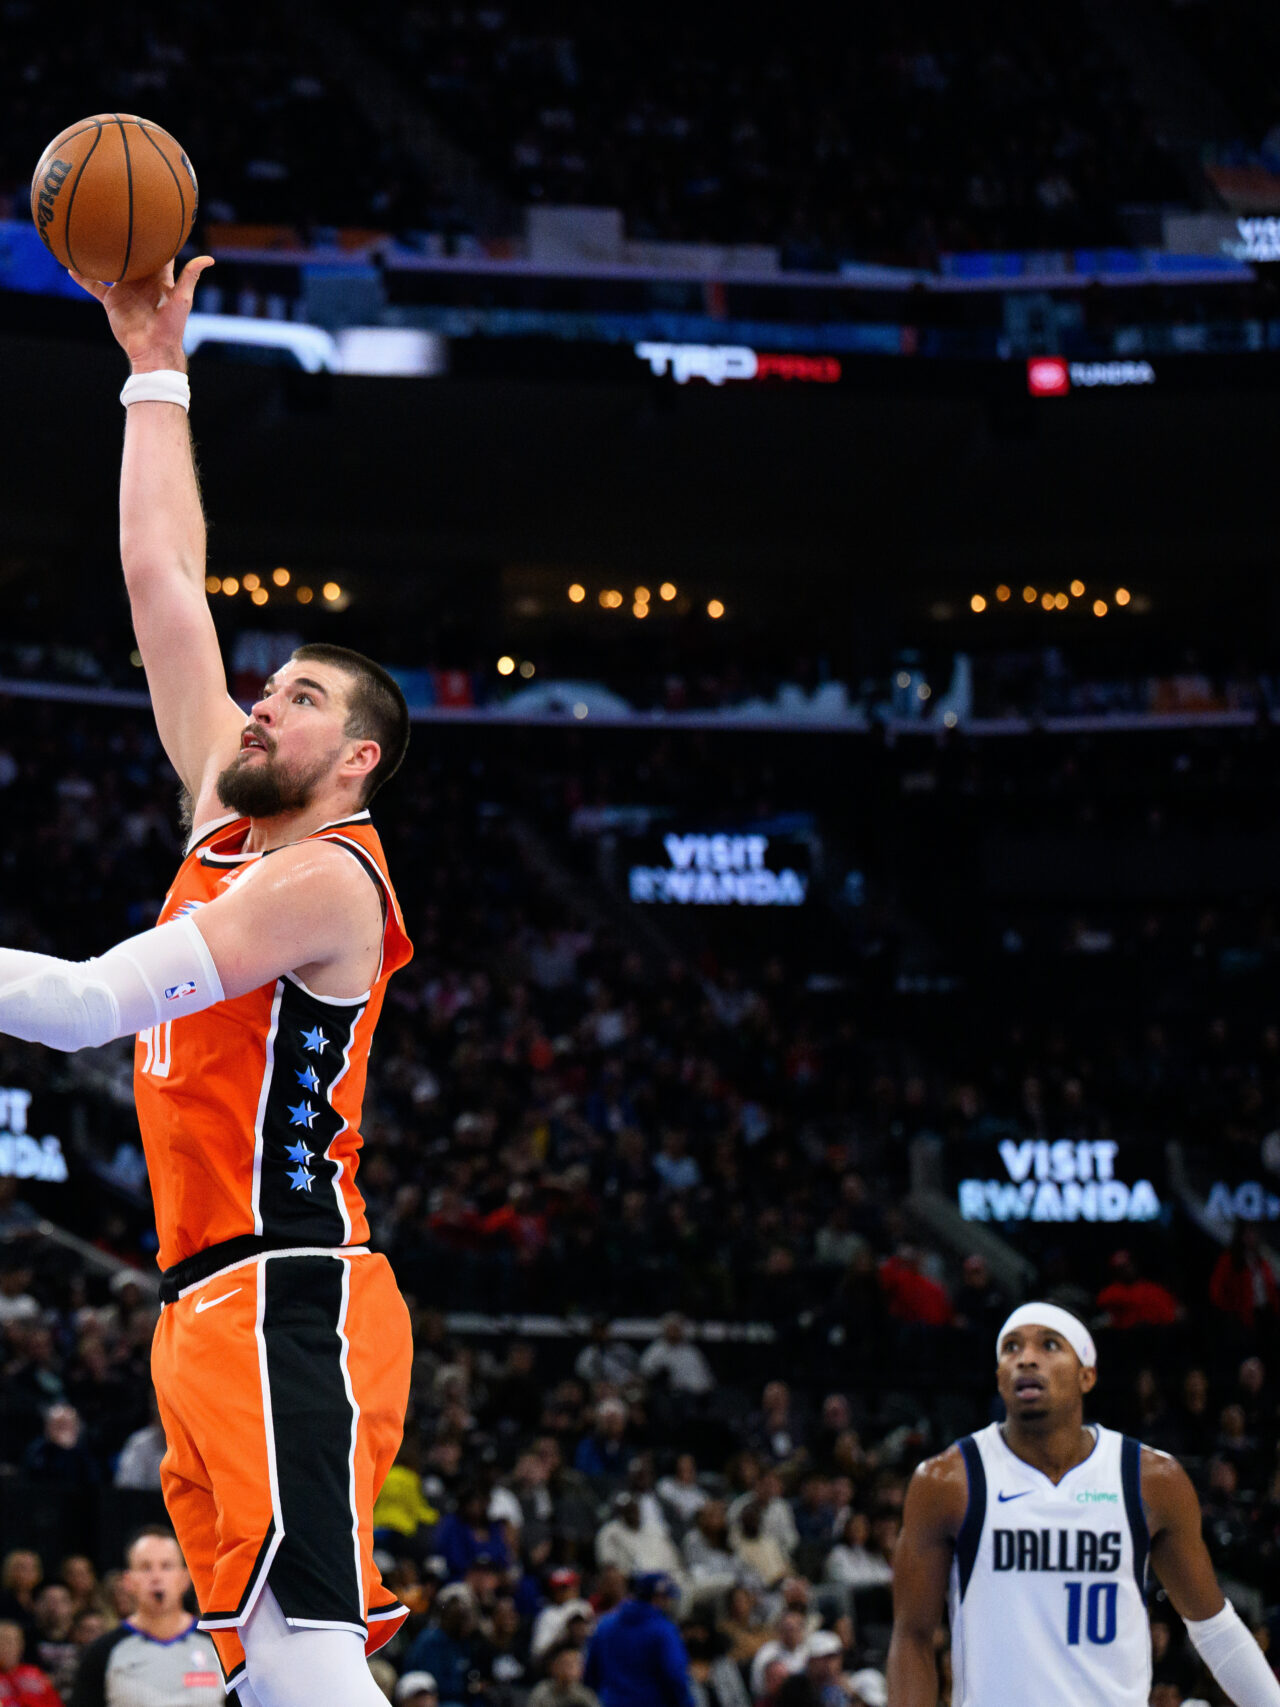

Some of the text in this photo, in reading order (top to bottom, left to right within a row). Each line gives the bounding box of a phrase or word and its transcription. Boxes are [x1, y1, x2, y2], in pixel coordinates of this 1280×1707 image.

[37, 159, 73, 253] Wilso
[998, 1140, 1119, 1183] VISIT
[958, 1178, 1162, 1222] RWANDA
[1076, 1489, 1119, 1503] chime
[992, 1528, 1122, 1574] DALLAS
[1064, 1581, 1119, 1646] 10
